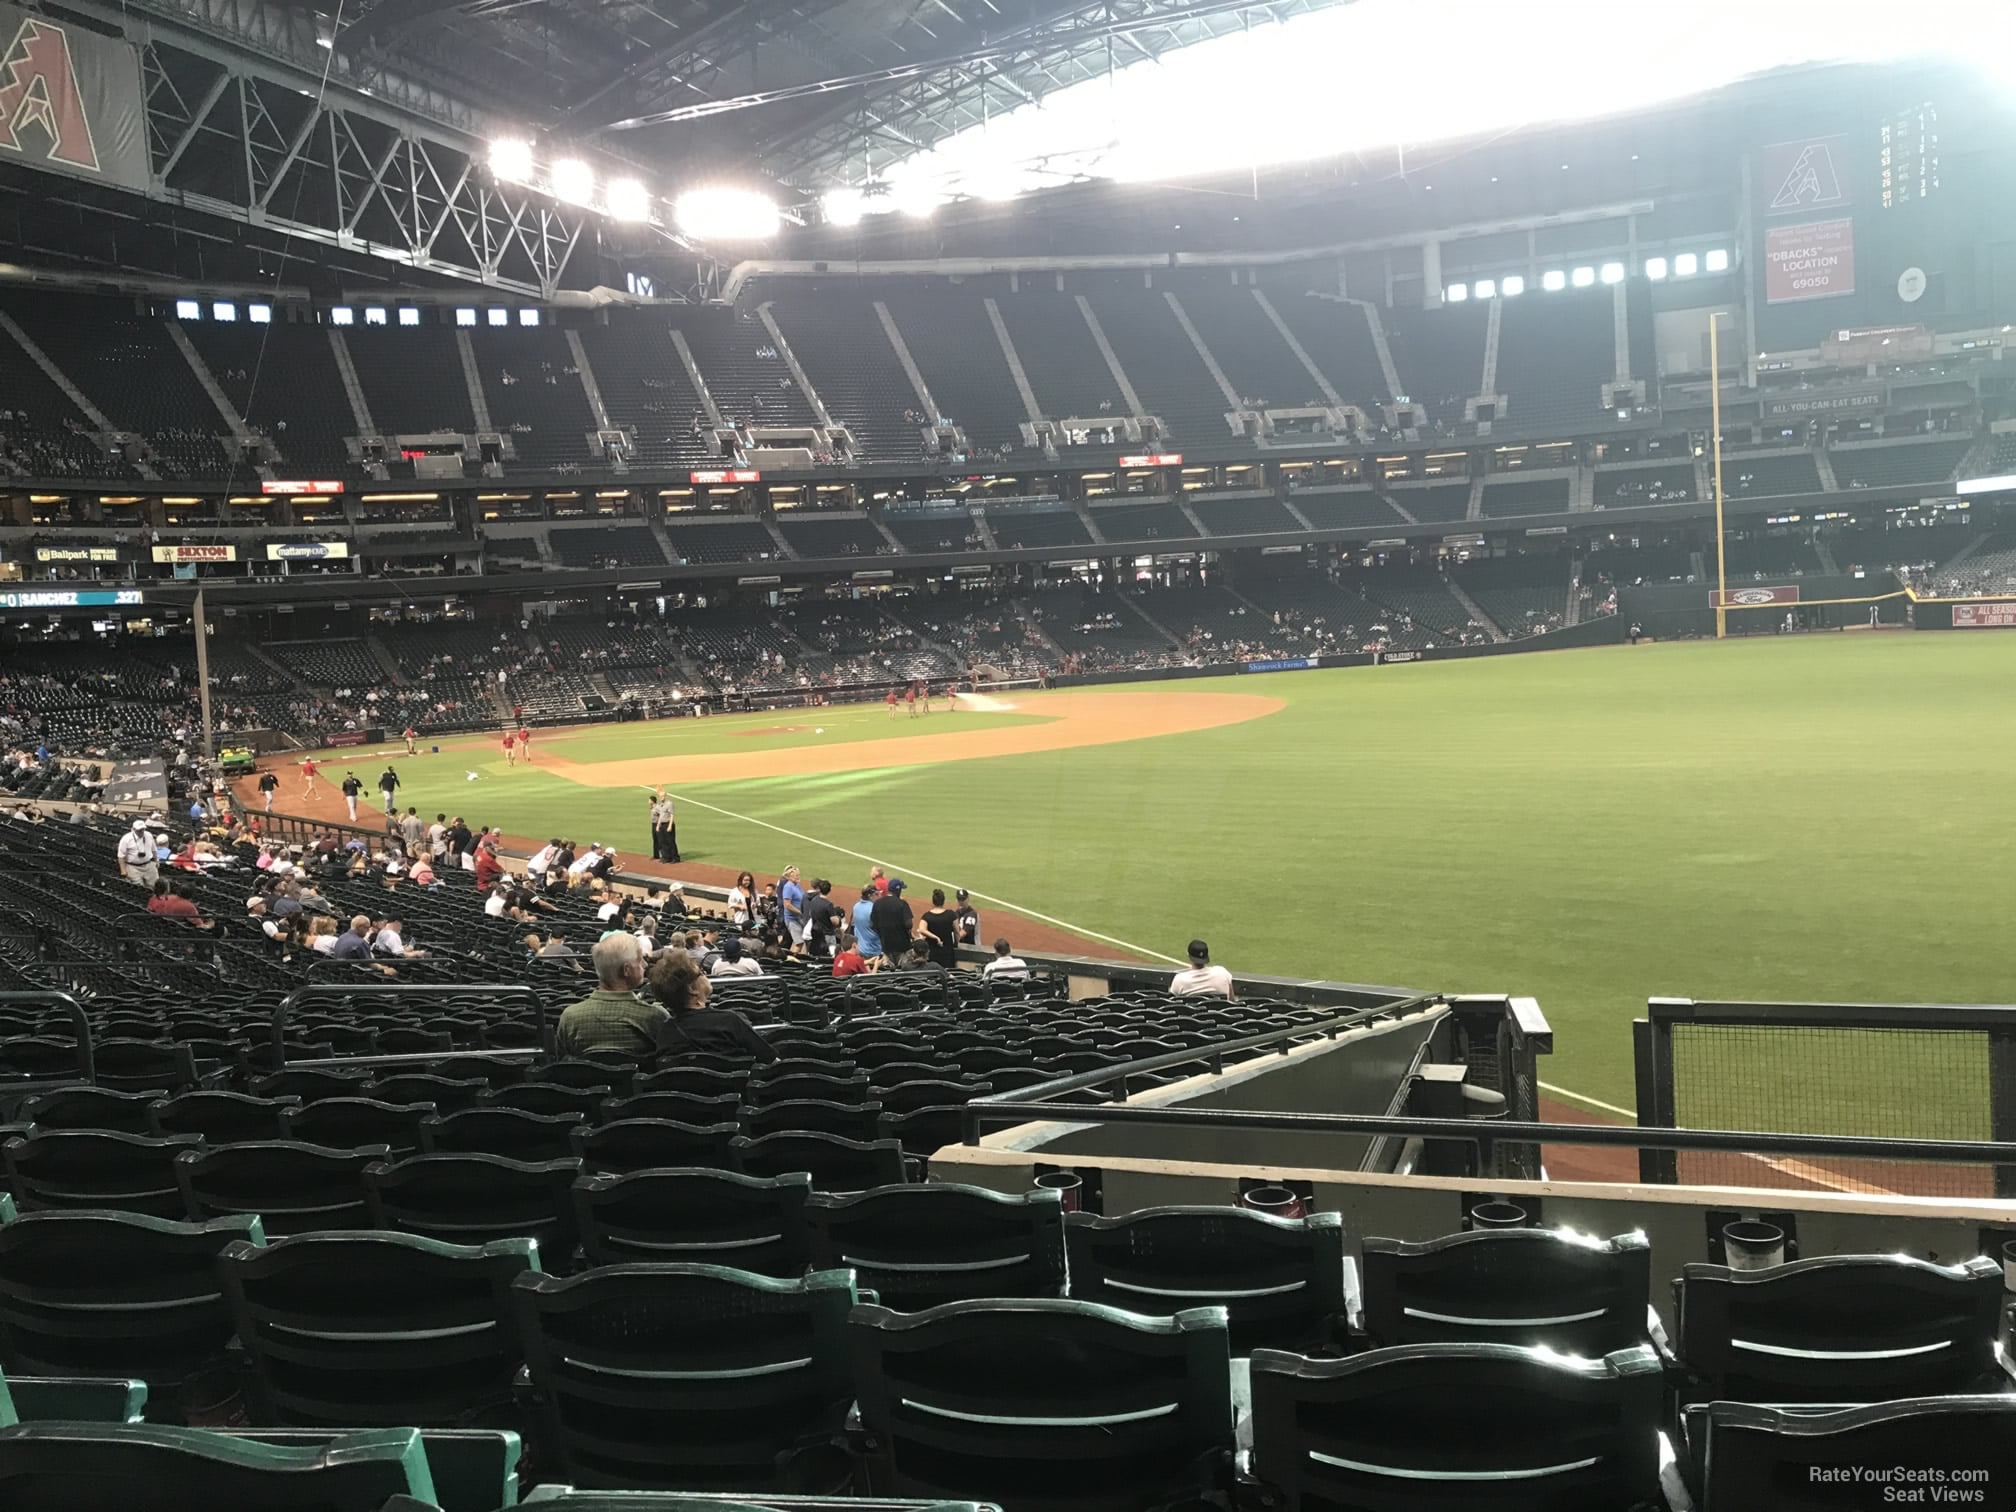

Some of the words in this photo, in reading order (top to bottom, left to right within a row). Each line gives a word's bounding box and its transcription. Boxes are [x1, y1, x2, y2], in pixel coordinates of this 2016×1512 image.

[1783, 256, 1838, 272] LOCATION
[1792, 276, 1829, 289] 69050
[1851, 395, 1879, 406] SEATS
[50, 549, 88, 561] Ballpark
[177, 547, 227, 557] SEXTON
[22, 592, 78, 606] SANCHEZ
[115, 591, 139, 604] .327
[1977, 606, 1991, 615] ALL
[1984, 614, 2002, 624] LONG
[1249, 661, 1282, 671] Shamrock
